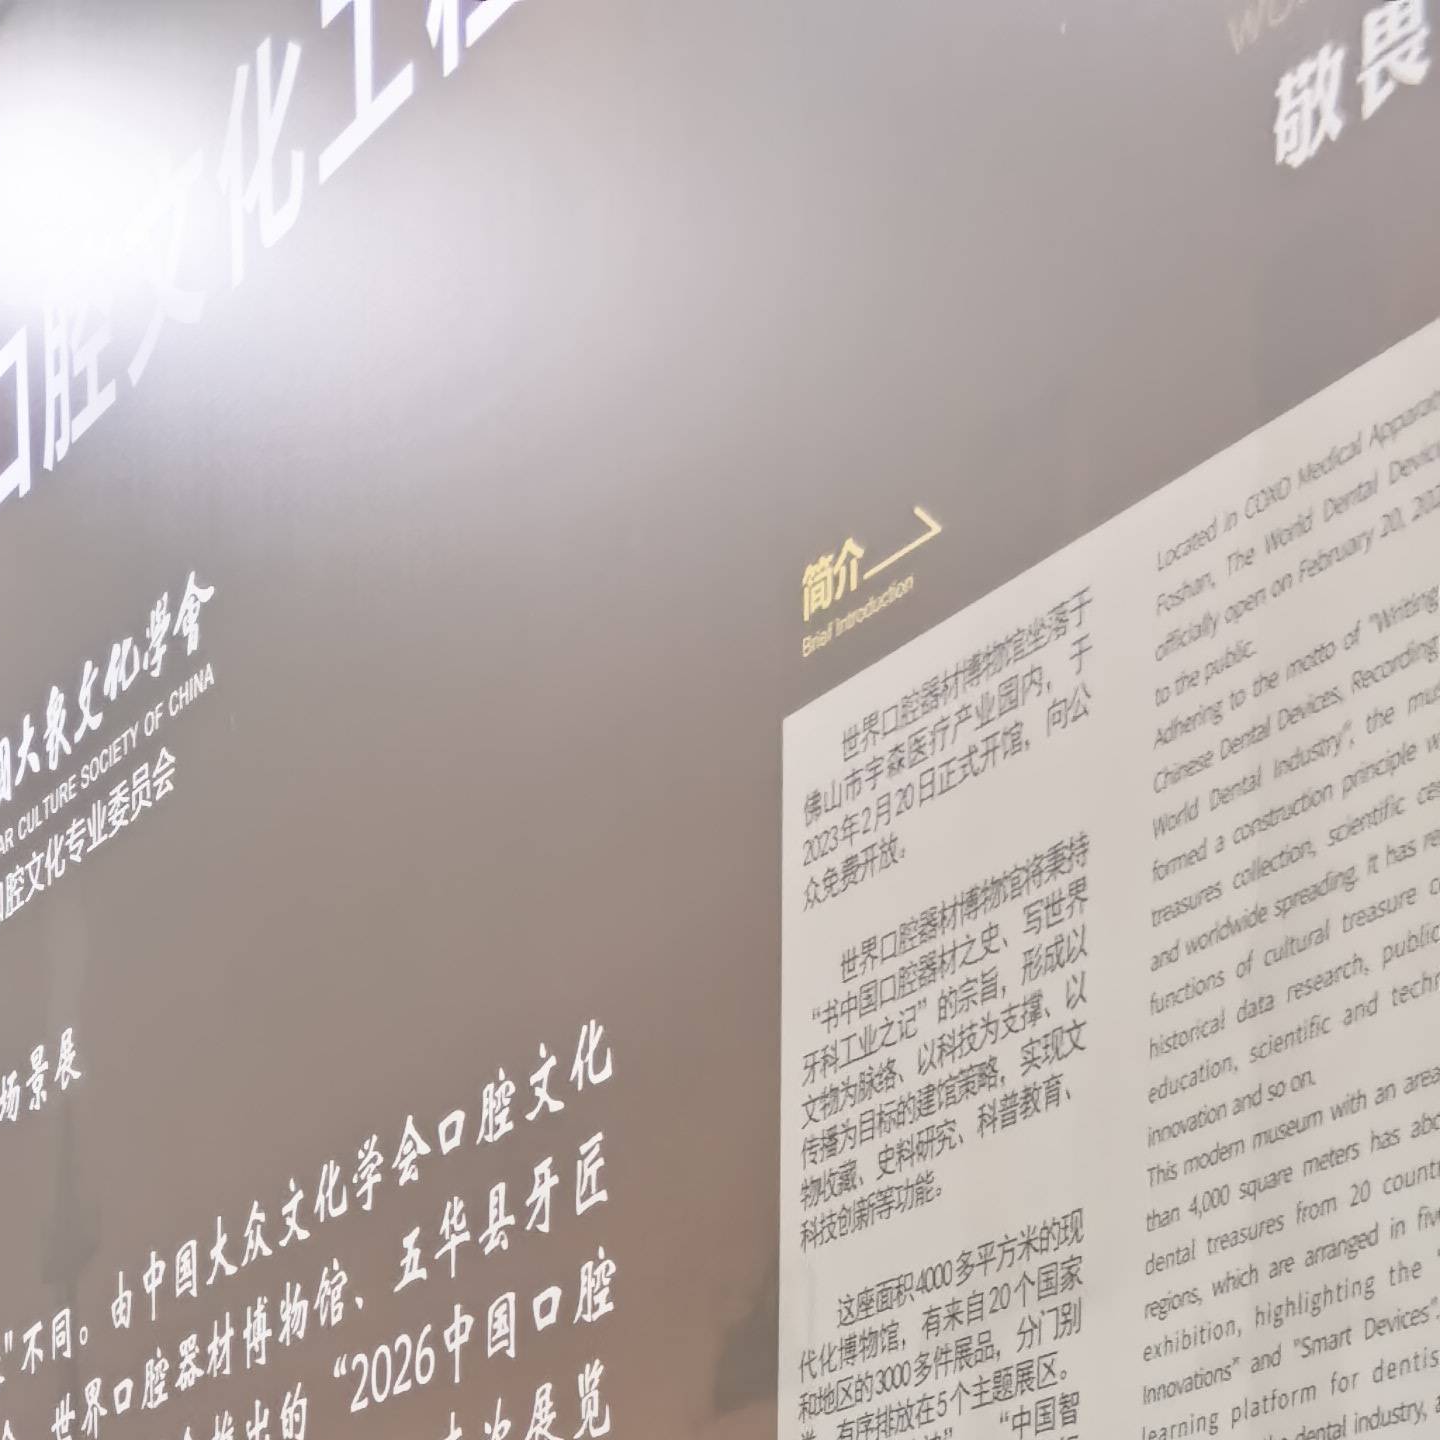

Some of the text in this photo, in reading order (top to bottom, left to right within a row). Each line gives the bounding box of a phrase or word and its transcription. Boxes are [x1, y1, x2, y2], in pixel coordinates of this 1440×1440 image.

[803, 536, 864, 622] 简介
[19, 776, 76, 841] CULTURE
[80, 722, 139, 788] SOCIETY
[144, 702, 164, 737] OF
[169, 663, 215, 717] CHINA
[800, 1169, 941, 1253] 科技创新等功能。
[1353, 1400, 1427, 1436] industry,
